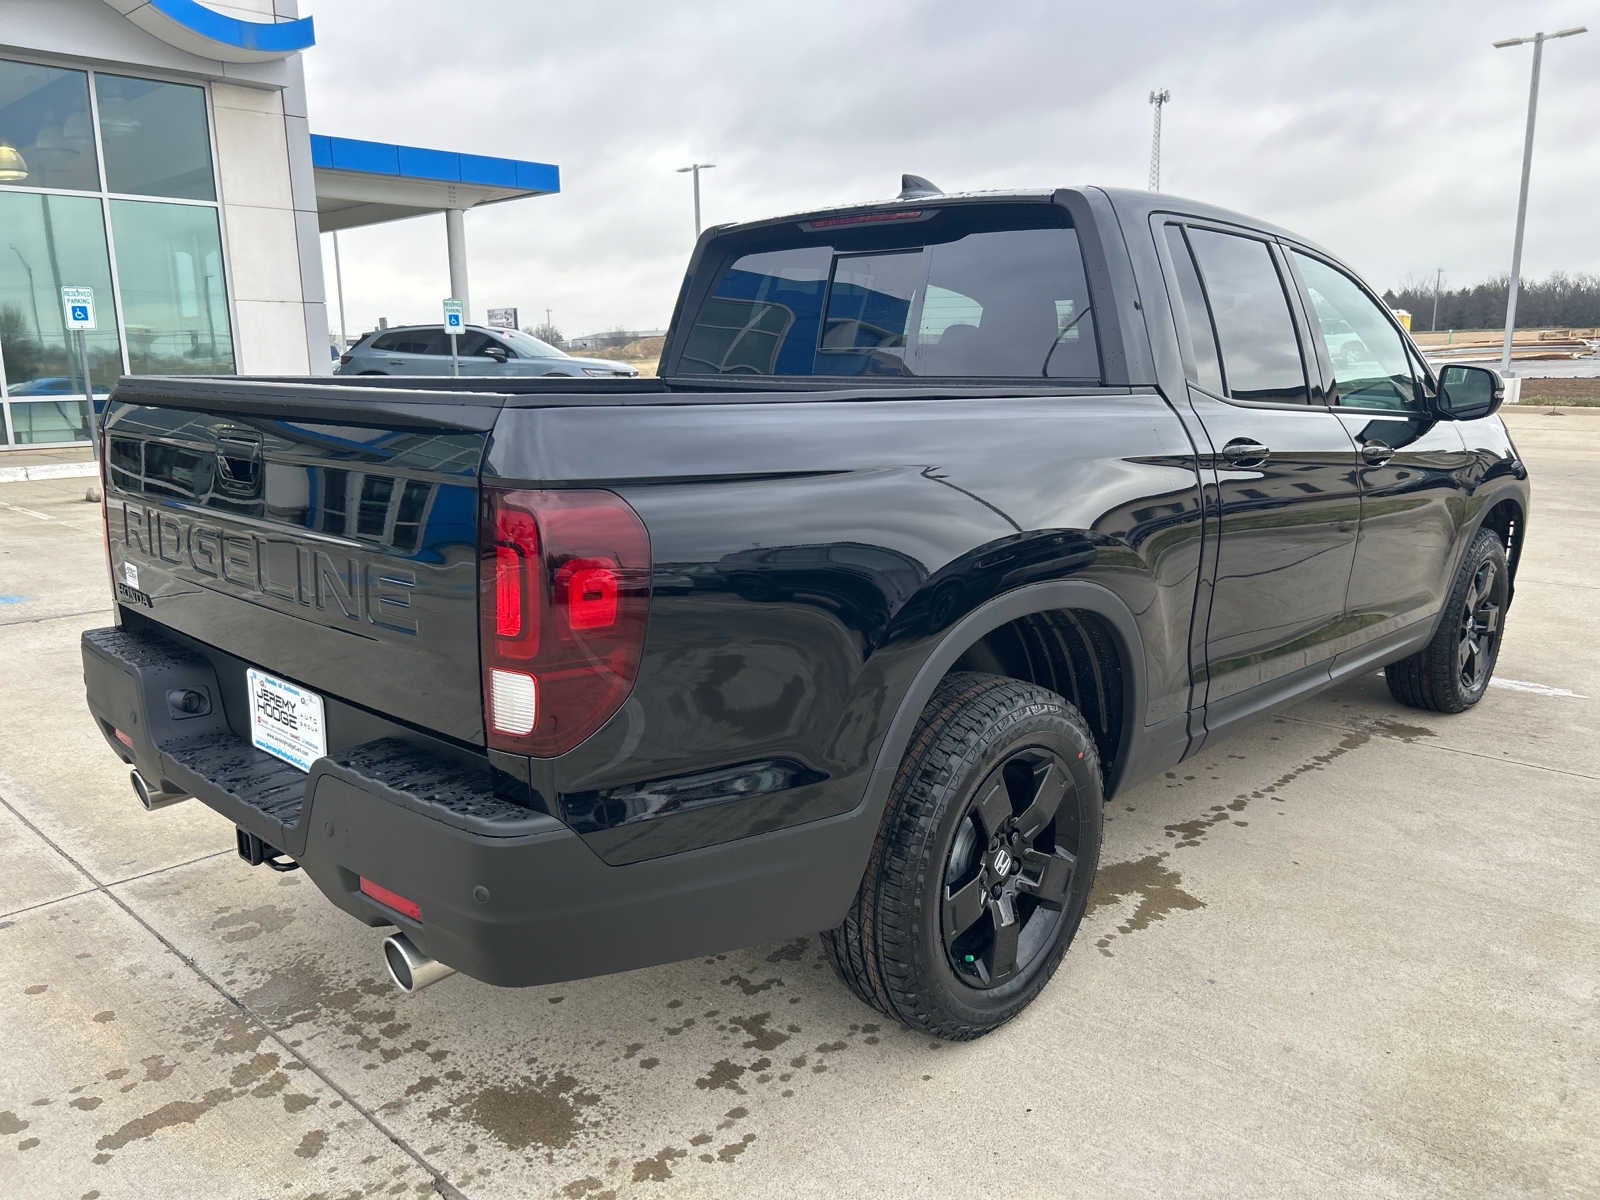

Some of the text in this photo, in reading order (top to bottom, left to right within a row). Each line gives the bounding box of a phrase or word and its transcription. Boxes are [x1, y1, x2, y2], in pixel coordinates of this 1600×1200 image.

[122, 501, 420, 637] RIDGELINE
[256, 688, 297, 714] JEREMY
[257, 698, 298, 731] HODGE
